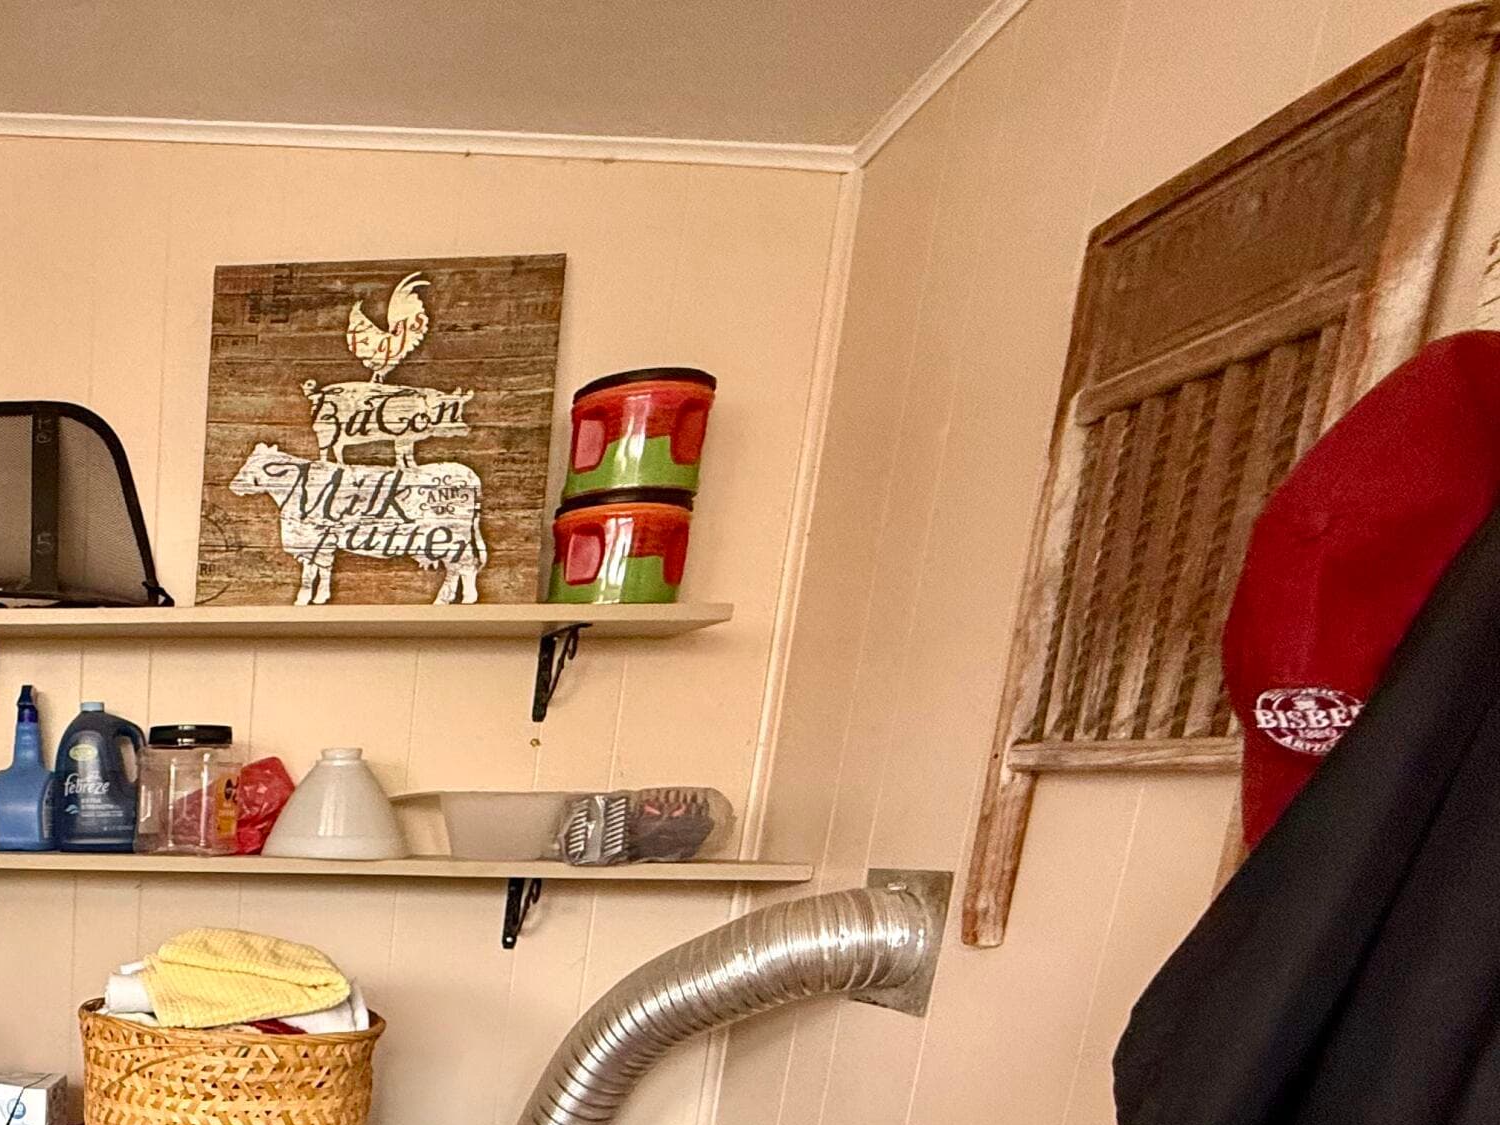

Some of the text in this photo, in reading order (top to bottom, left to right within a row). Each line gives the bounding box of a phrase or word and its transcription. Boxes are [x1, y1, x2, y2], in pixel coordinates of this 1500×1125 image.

[348, 311, 428, 371] Eggs
[263, 461, 415, 524] Milk
[309, 522, 479, 568] Butter
[64, 772, 110, 796] febreze
